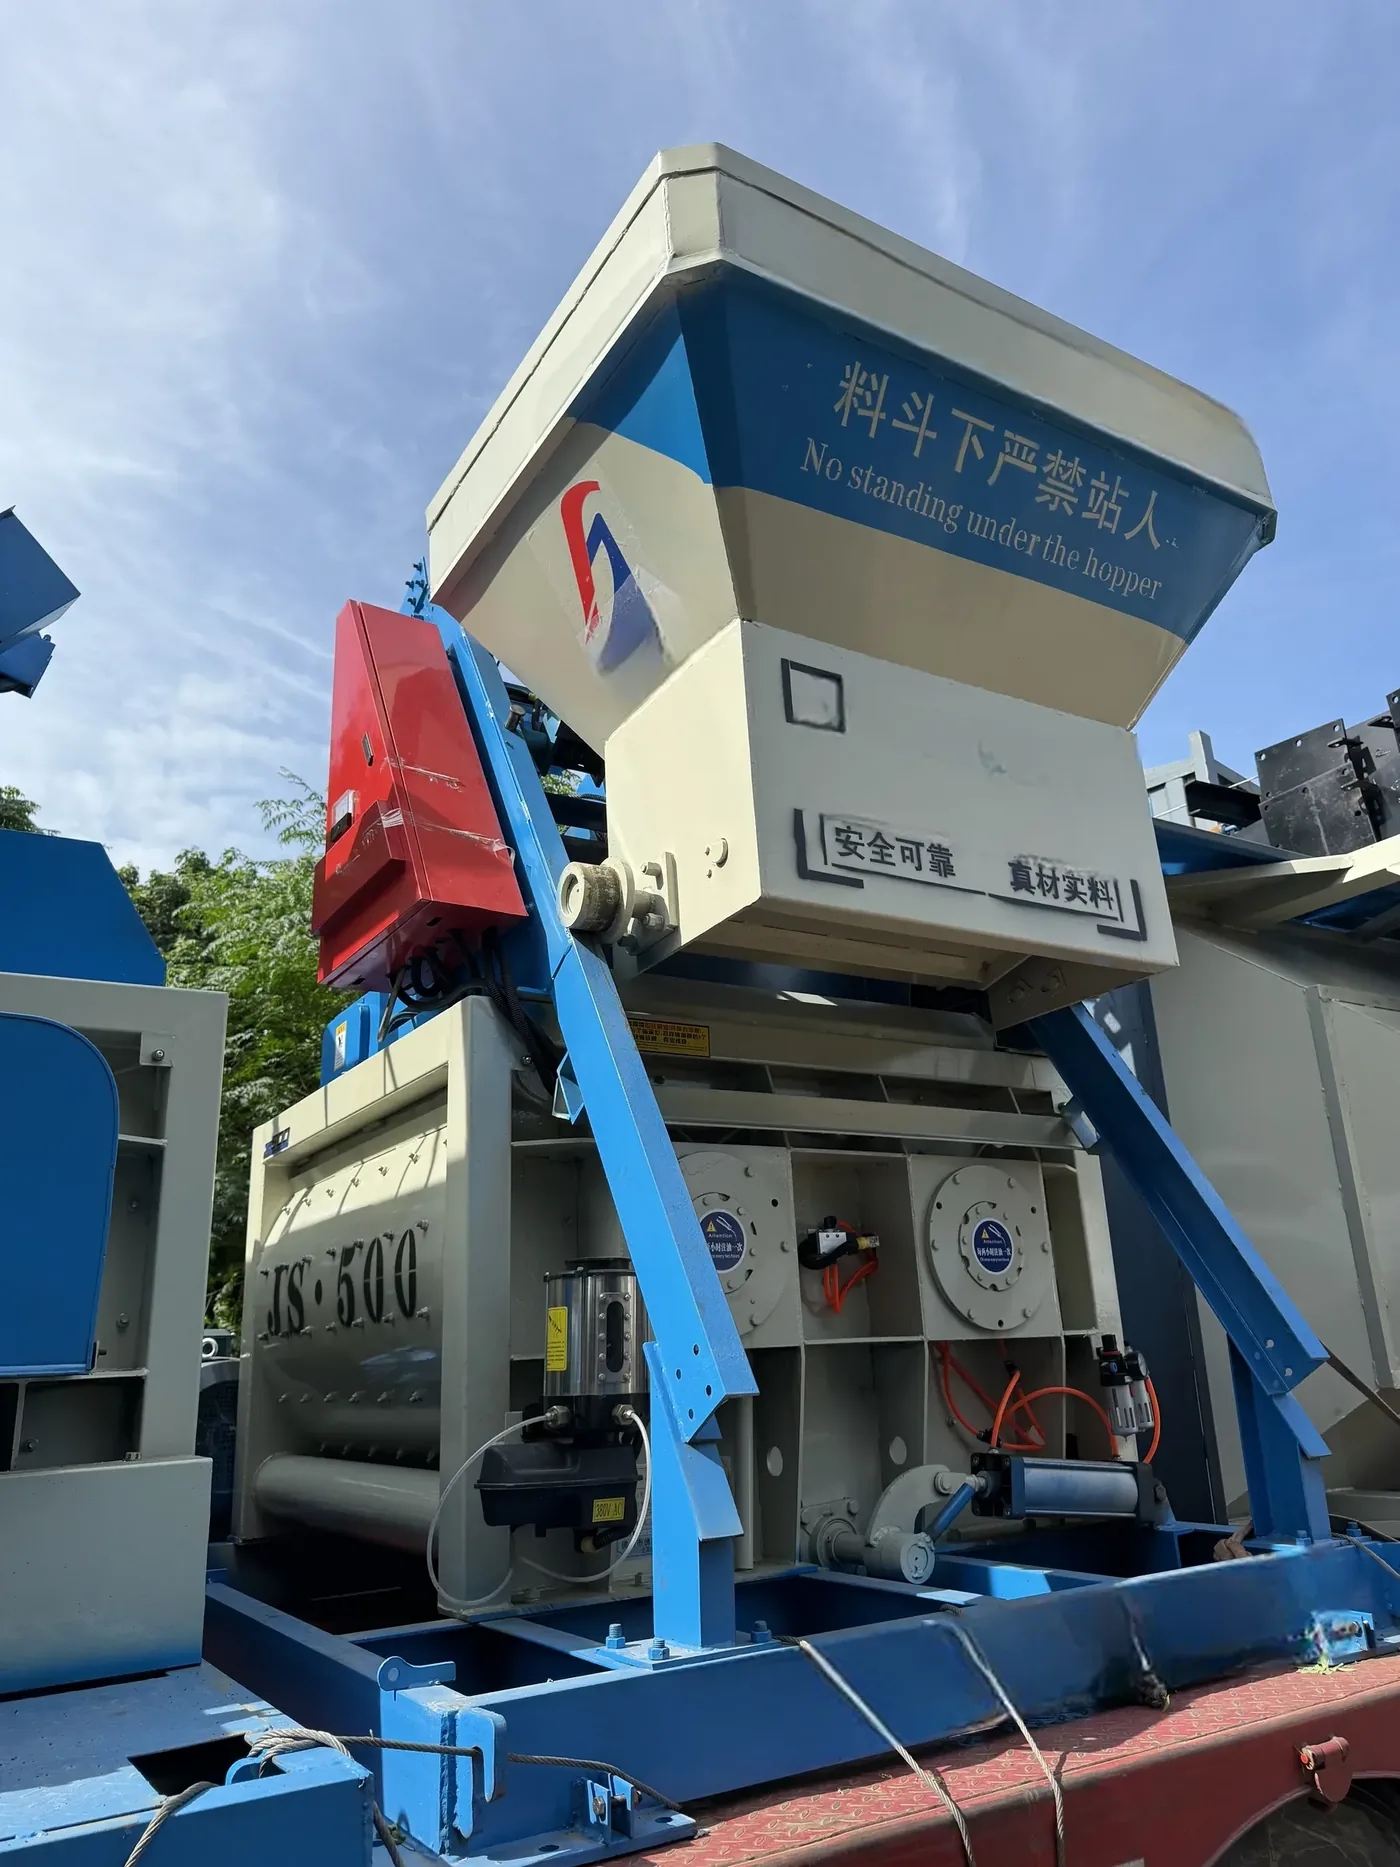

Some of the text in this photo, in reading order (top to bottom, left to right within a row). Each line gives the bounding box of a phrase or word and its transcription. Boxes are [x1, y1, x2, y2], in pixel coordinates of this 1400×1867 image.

[834, 361, 1161, 550] 料斗下严禁站人
[800, 437, 1162, 600] No standing under the hopper
[834, 825, 1115, 910] 安全可靠 真材实料
[596, 1502, 622, 1518] 380V AC
